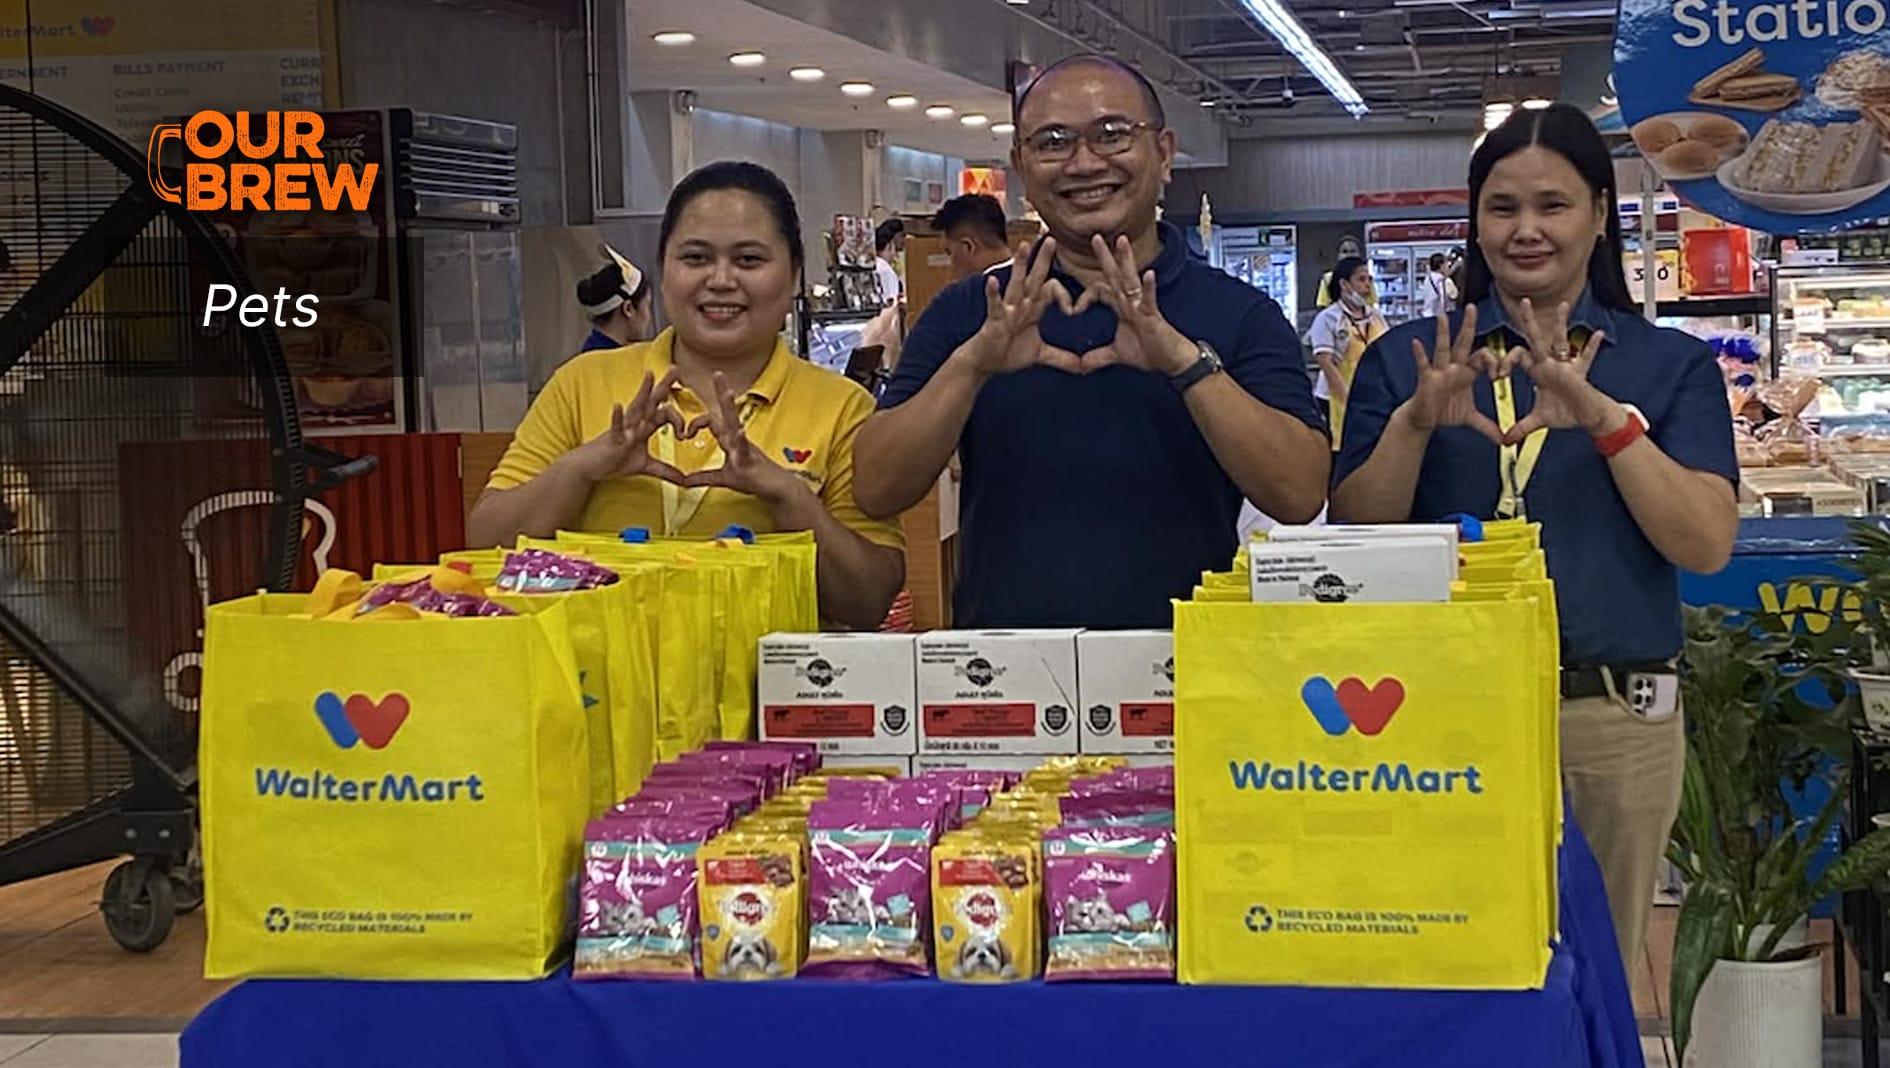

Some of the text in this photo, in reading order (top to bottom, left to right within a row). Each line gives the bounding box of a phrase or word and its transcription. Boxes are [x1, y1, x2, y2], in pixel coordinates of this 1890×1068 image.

[1672, 0, 1887, 47] Statio
[113, 60, 224, 76] BILLS PAYMENT
[1634, 267, 1669, 281] 30
[255, 766, 485, 802] WalterMart
[1229, 760, 1484, 794] WalterMart
[294, 910, 318, 920] THIS
[322, 911, 346, 921] ECO
[350, 911, 373, 921] BAG
[376, 911, 387, 921] IS
[425, 912, 456, 922] MADE
[459, 912, 474, 922] BY
[1277, 909, 1304, 919] THIS
[1307, 910, 1333, 920] ECO
[1337, 910, 1363, 921] BAG
[1366, 911, 1377, 921] IS
[1418, 913, 1450, 923] MADE
[1454, 914, 1468, 923] BY
[294, 922, 425, 934] RECYCLED MATERIALS
[1277, 922, 1419, 935] RECYCLED MATERIALS
